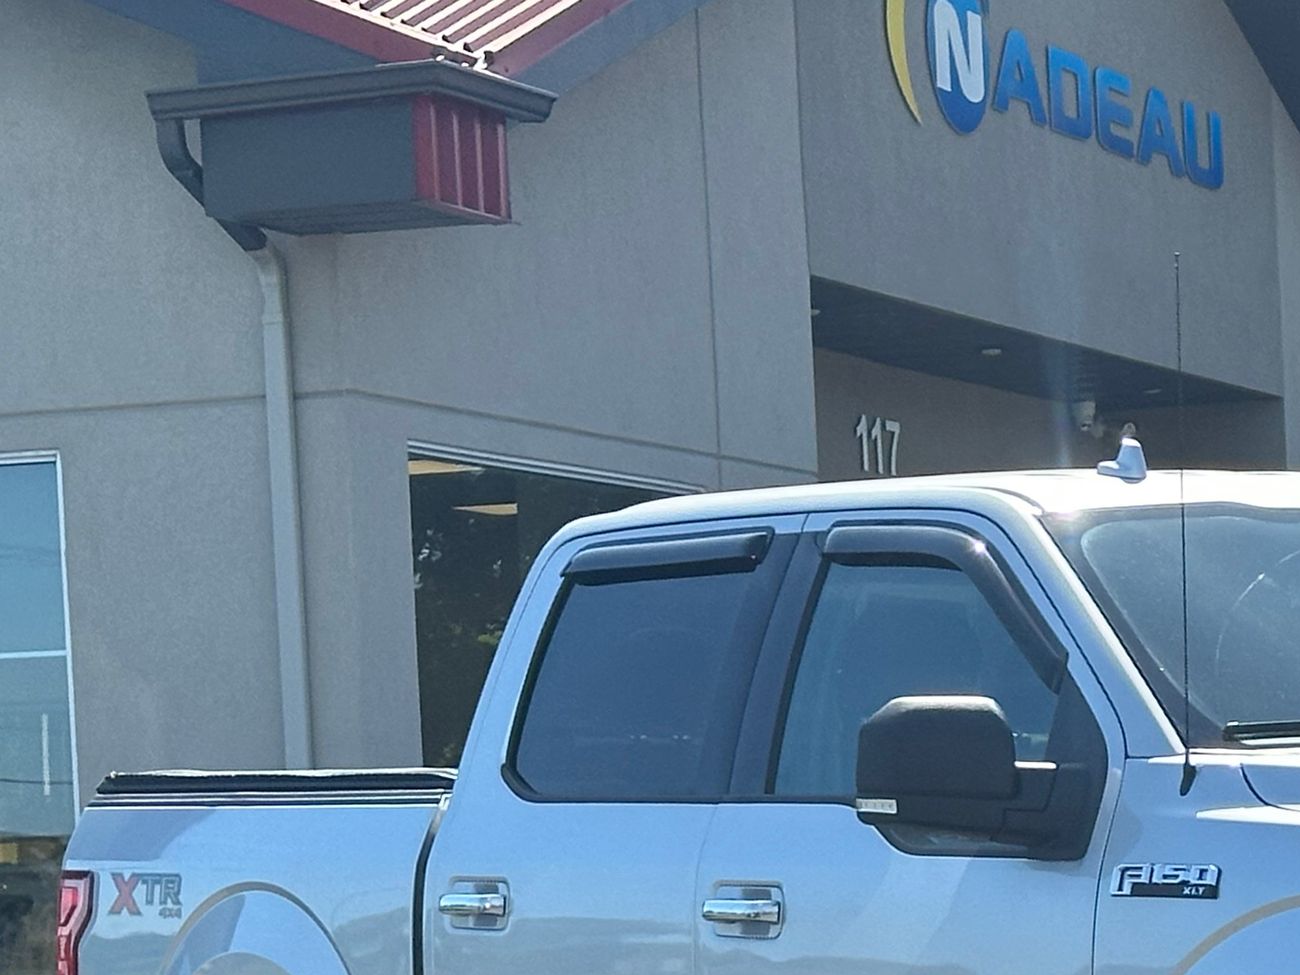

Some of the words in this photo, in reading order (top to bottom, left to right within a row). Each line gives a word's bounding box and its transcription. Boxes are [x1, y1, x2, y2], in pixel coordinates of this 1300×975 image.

[934, 0, 1224, 190] NADEAU
[856, 413, 900, 476] 117
[107, 872, 183, 916] XTR
[1183, 886, 1205, 896] XLT
